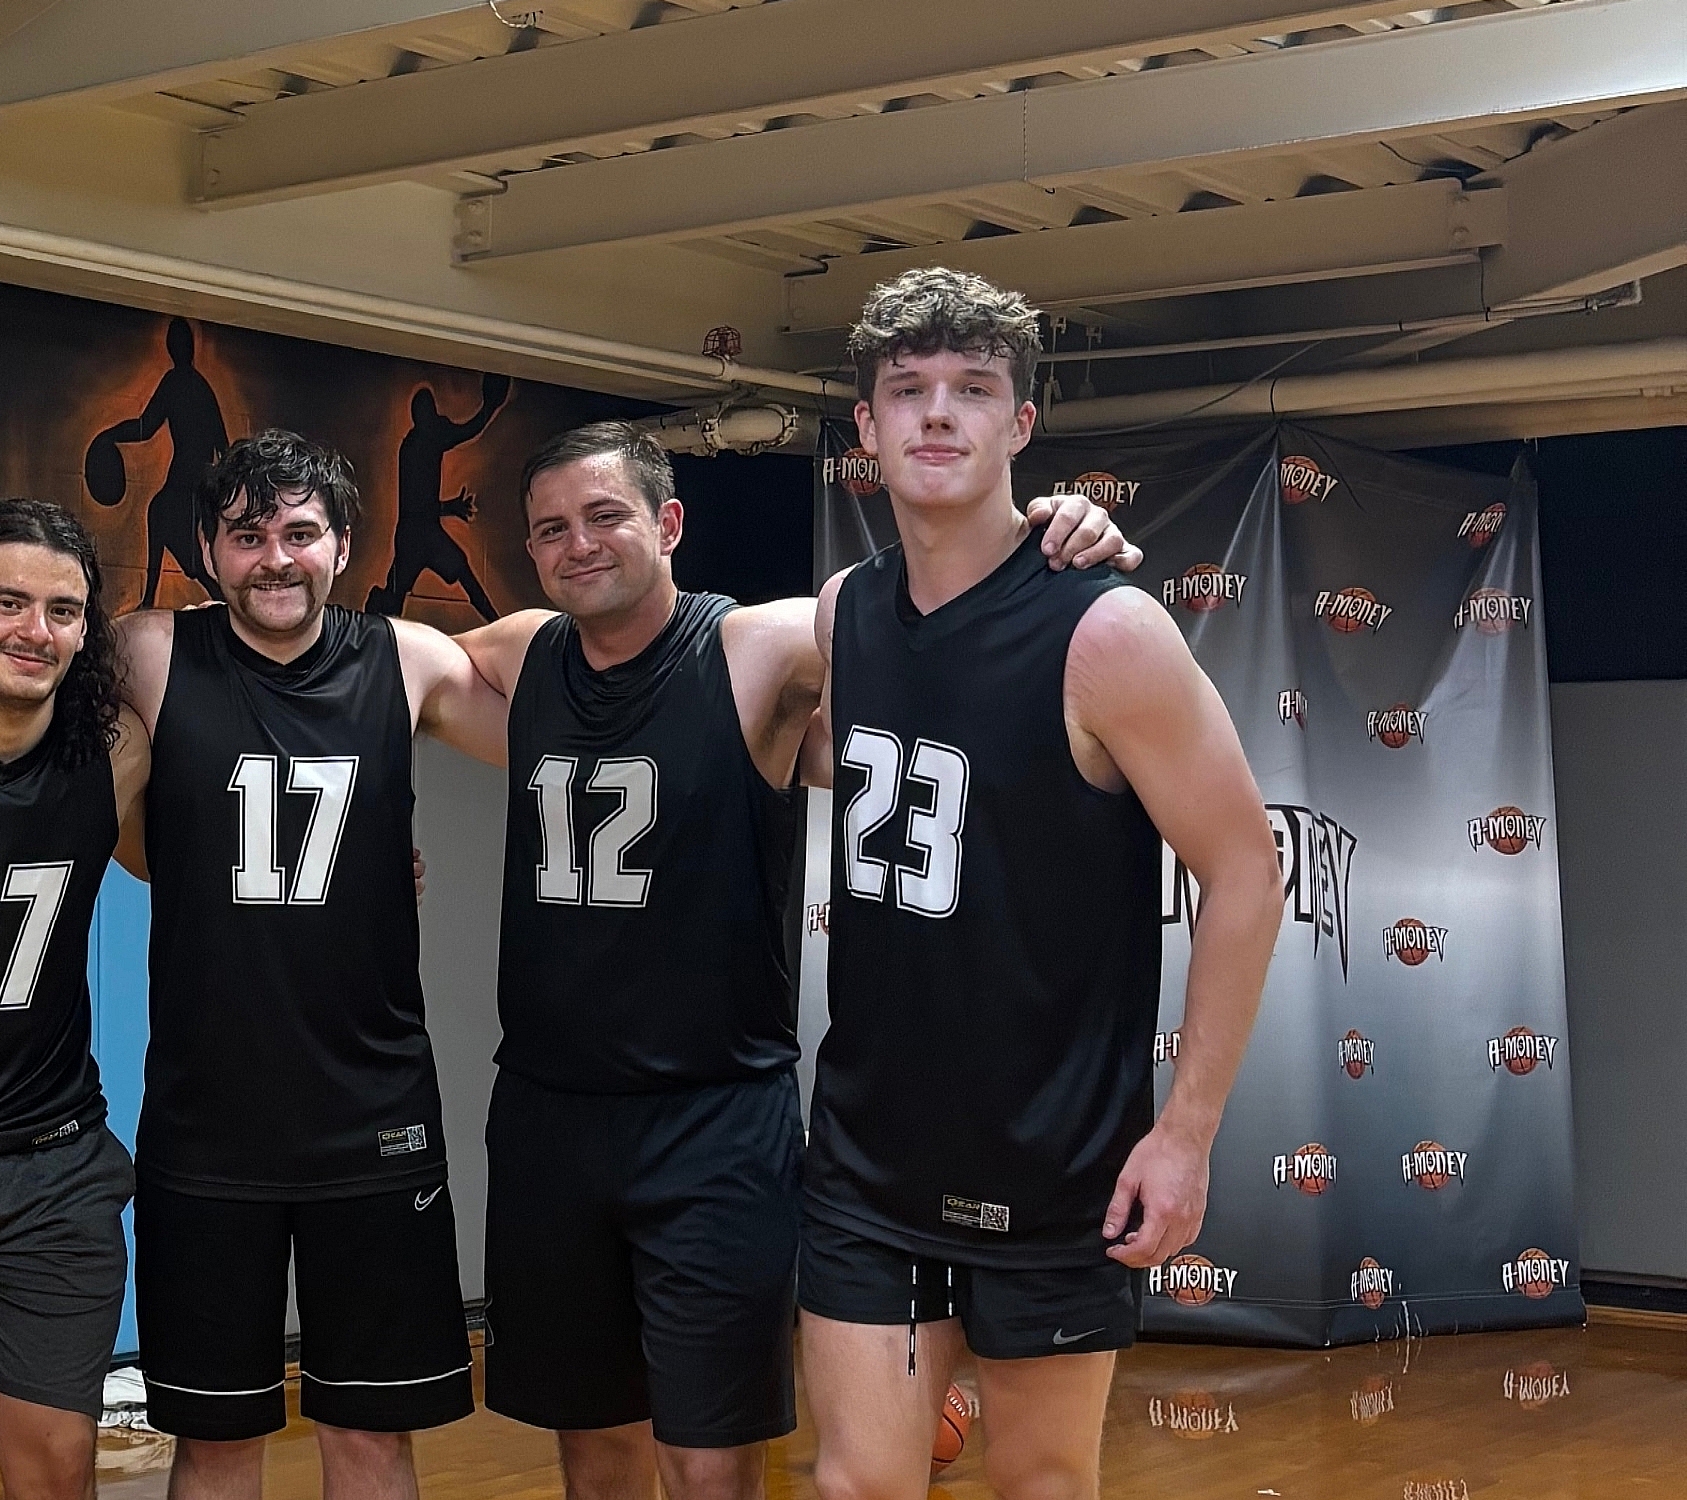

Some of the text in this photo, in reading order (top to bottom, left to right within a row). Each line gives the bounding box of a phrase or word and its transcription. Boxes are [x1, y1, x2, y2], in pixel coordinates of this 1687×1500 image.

[823, 457, 885, 487] A-MON
[1280, 462, 1340, 503] MONEY
[1456, 511, 1505, 539] A-MON
[226, 754, 360, 905] 17
[527, 755, 659, 907] 12
[840, 723, 971, 920] 23
